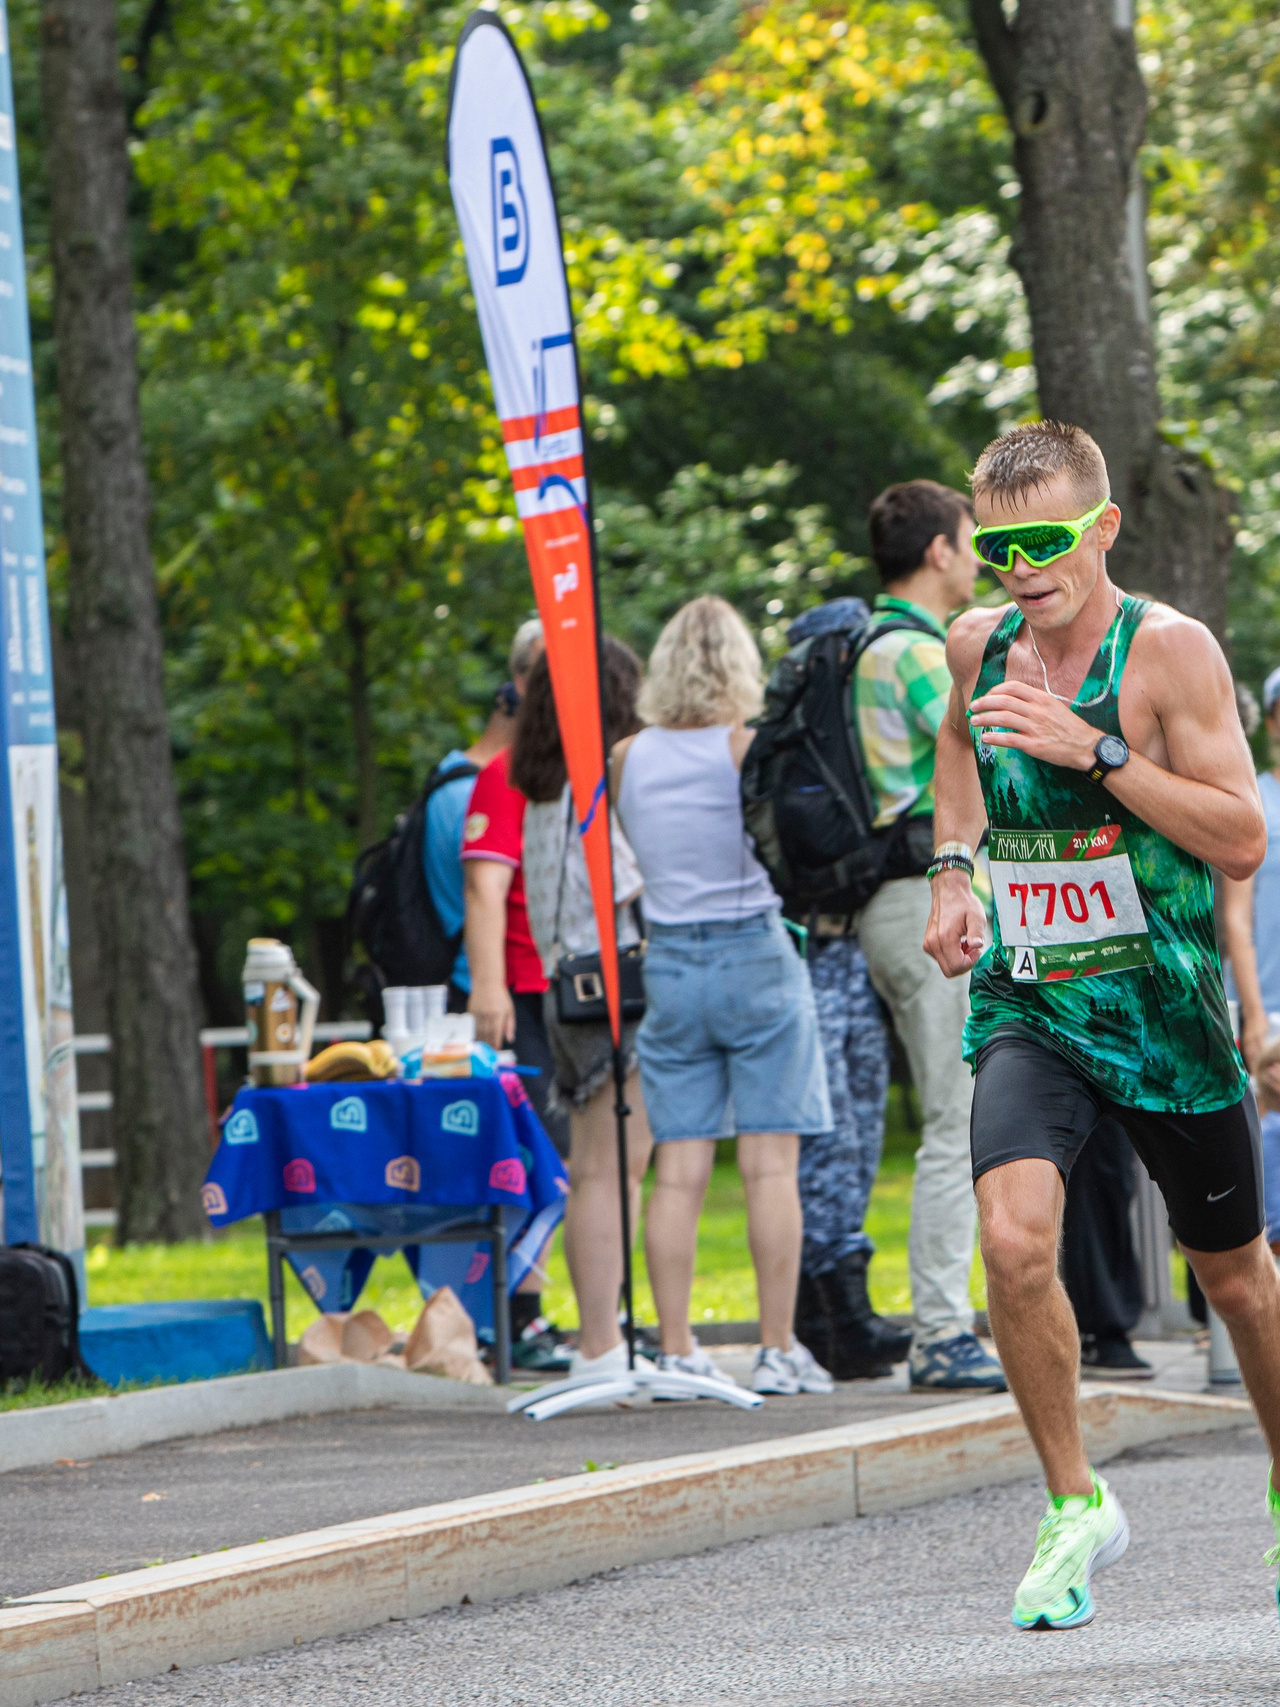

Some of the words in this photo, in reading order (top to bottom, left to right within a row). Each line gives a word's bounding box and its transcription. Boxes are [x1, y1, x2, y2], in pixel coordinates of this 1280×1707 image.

[997, 837, 1056, 860] ЛУЖНИКИ
[1073, 838, 1089, 850] 21,1
[1008, 880, 1116, 927] 7701
[1017, 950, 1034, 975] A
